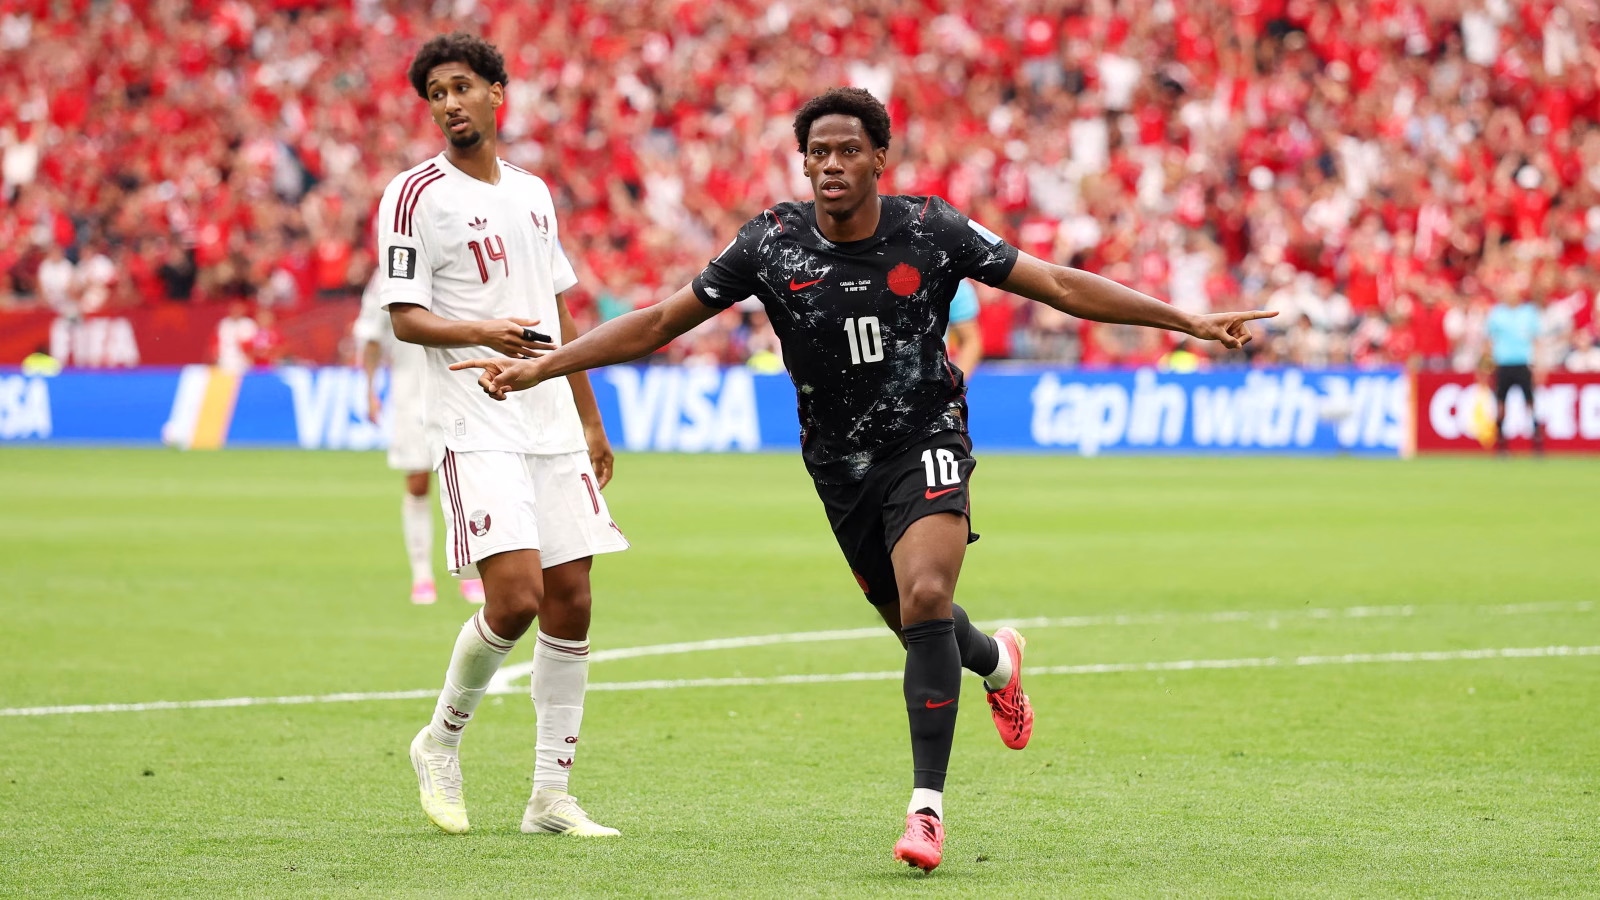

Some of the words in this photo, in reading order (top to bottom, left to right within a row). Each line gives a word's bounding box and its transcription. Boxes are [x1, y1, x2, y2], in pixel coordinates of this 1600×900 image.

[468, 234, 509, 284] 14
[843, 316, 884, 365] 10
[0, 373, 52, 438] SA
[282, 366, 396, 450] VIS
[605, 364, 762, 451] VISA
[1031, 372, 1129, 457] tap
[1192, 369, 1319, 446] with
[921, 448, 962, 487] 10
